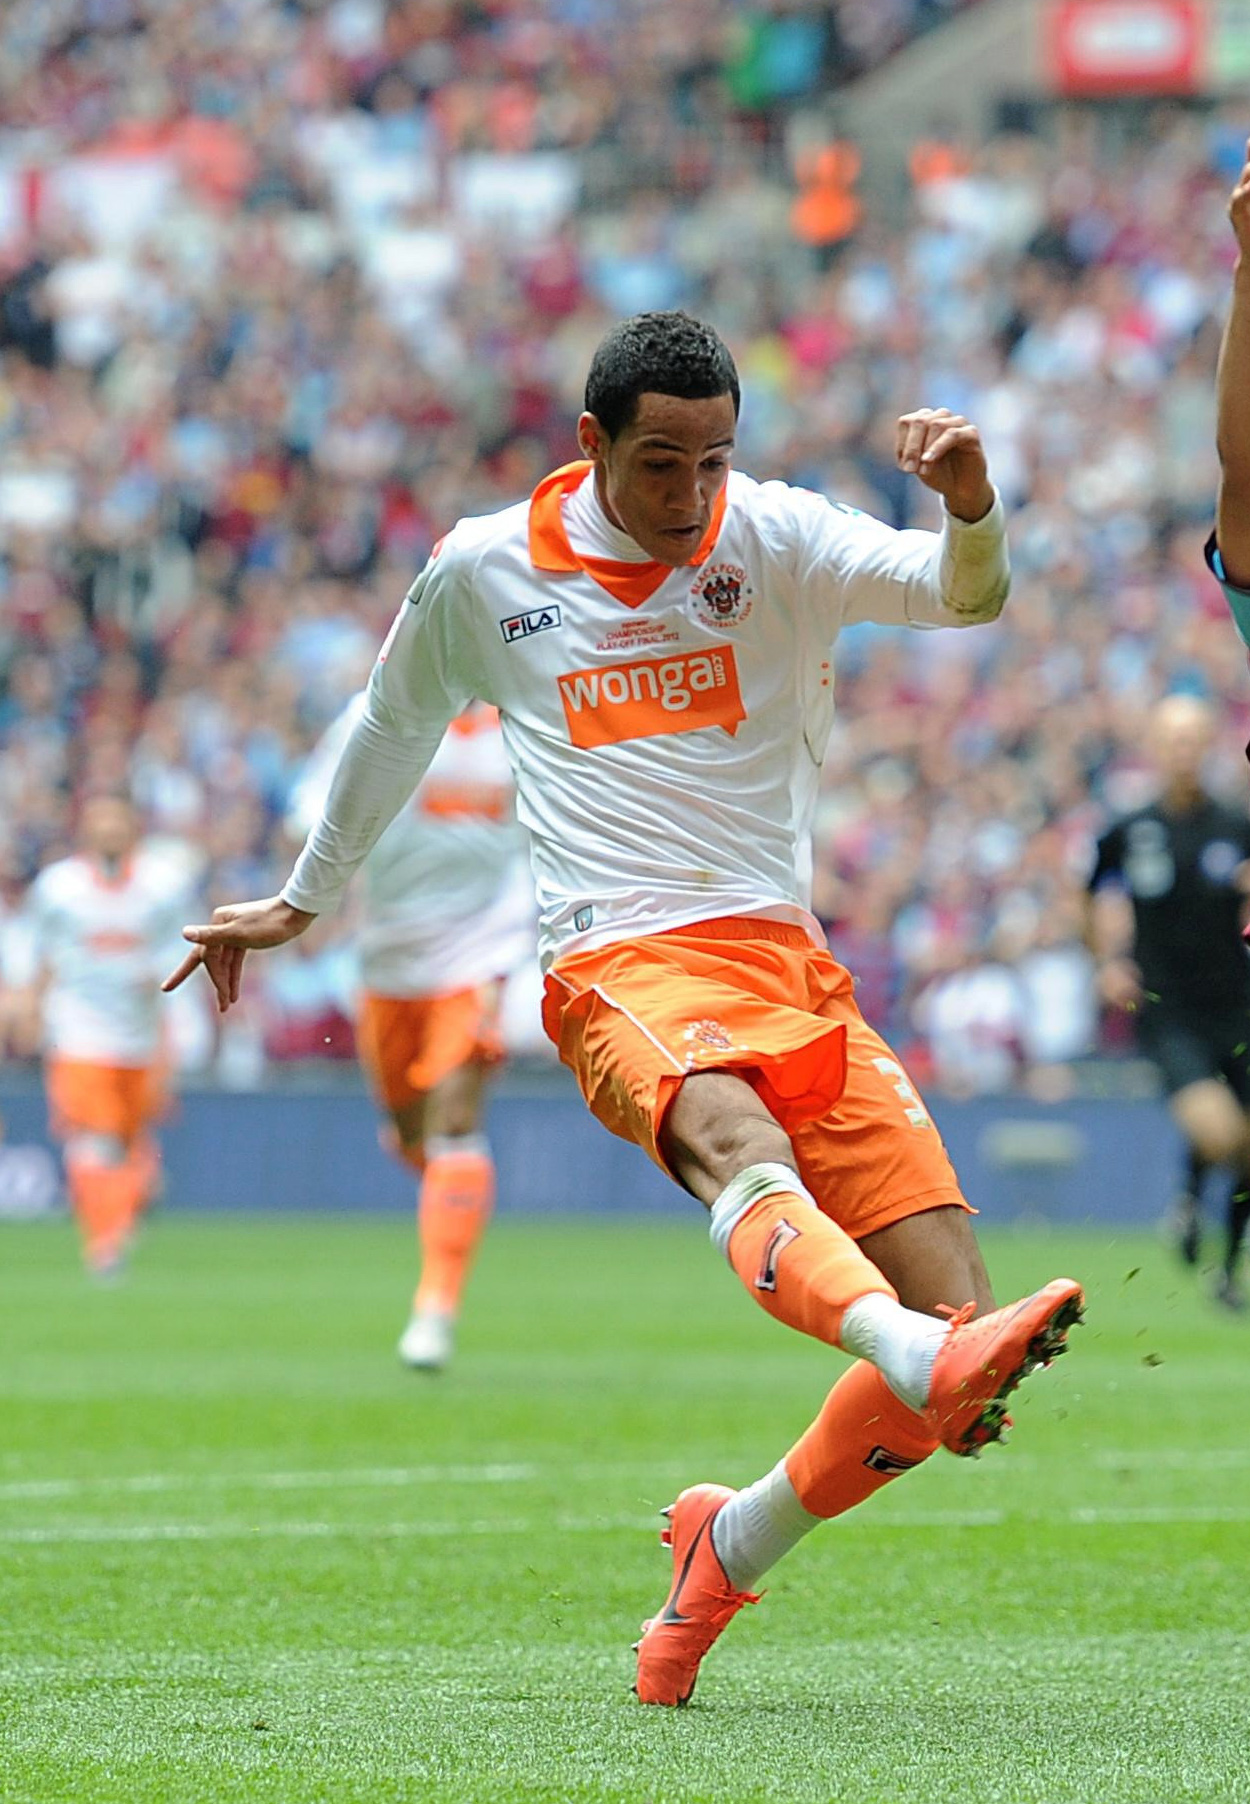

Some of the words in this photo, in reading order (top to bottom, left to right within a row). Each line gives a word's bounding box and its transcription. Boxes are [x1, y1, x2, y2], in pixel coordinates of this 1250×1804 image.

[691, 563, 748, 595] BLACKPOOL
[507, 612, 554, 641] FILA
[560, 656, 716, 712] wonga
